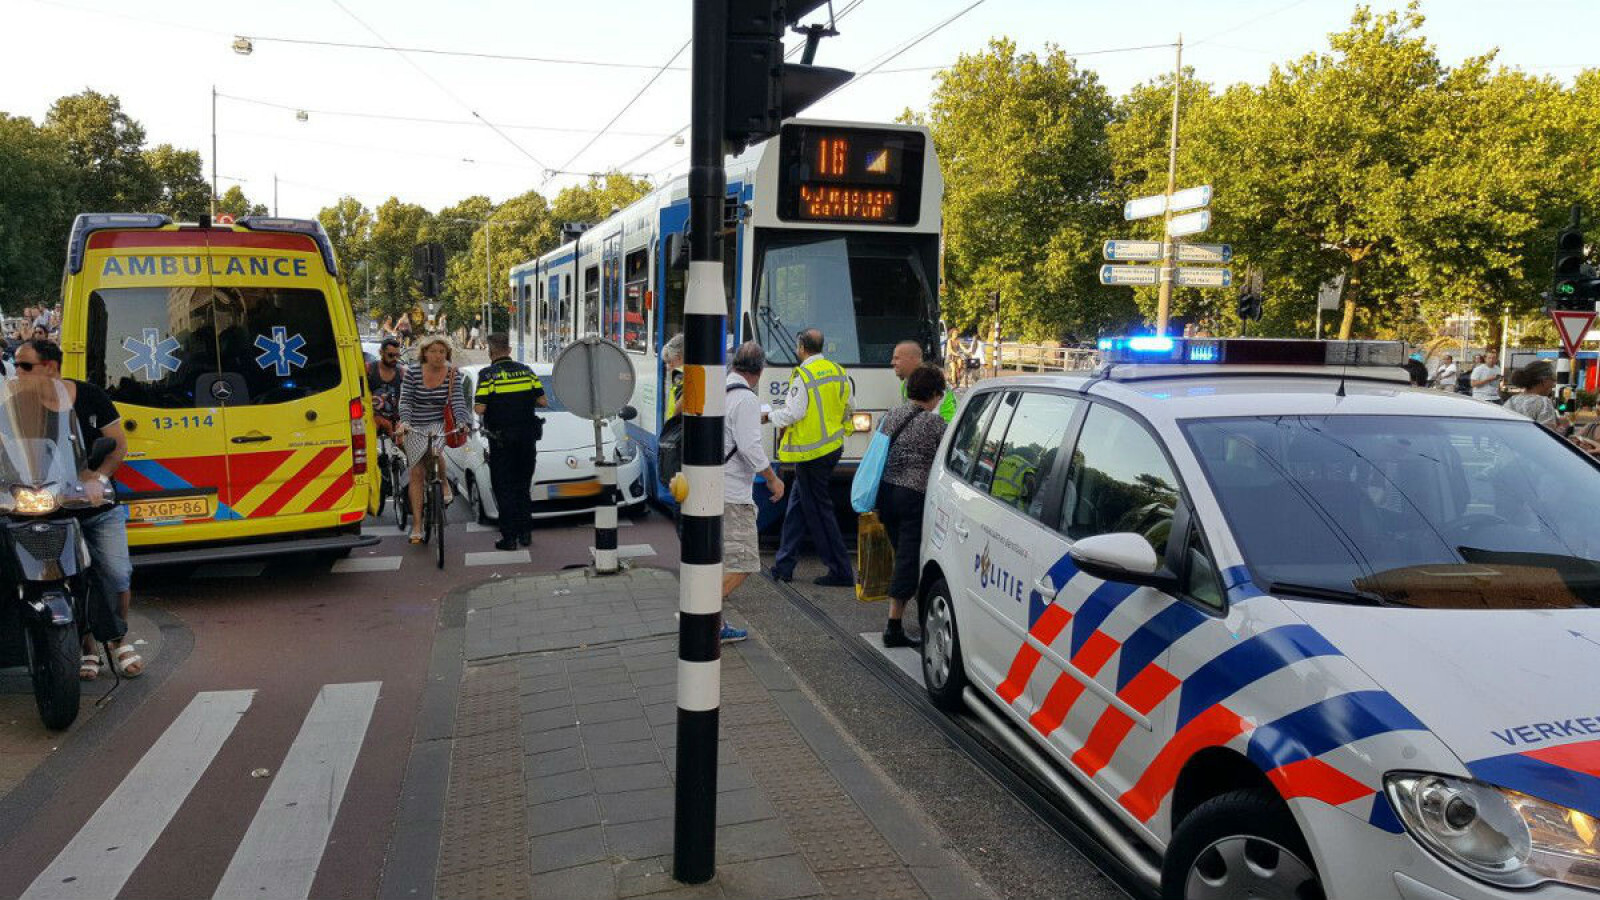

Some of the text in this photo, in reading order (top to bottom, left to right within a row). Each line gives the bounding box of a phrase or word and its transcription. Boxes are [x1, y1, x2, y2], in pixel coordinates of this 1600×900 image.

[102, 255, 308, 276] AMBULANCE
[151, 415, 214, 429] 13-114
[135, 501, 203, 517] 2-XGP-86
[974, 552, 1024, 604] POLITIE
